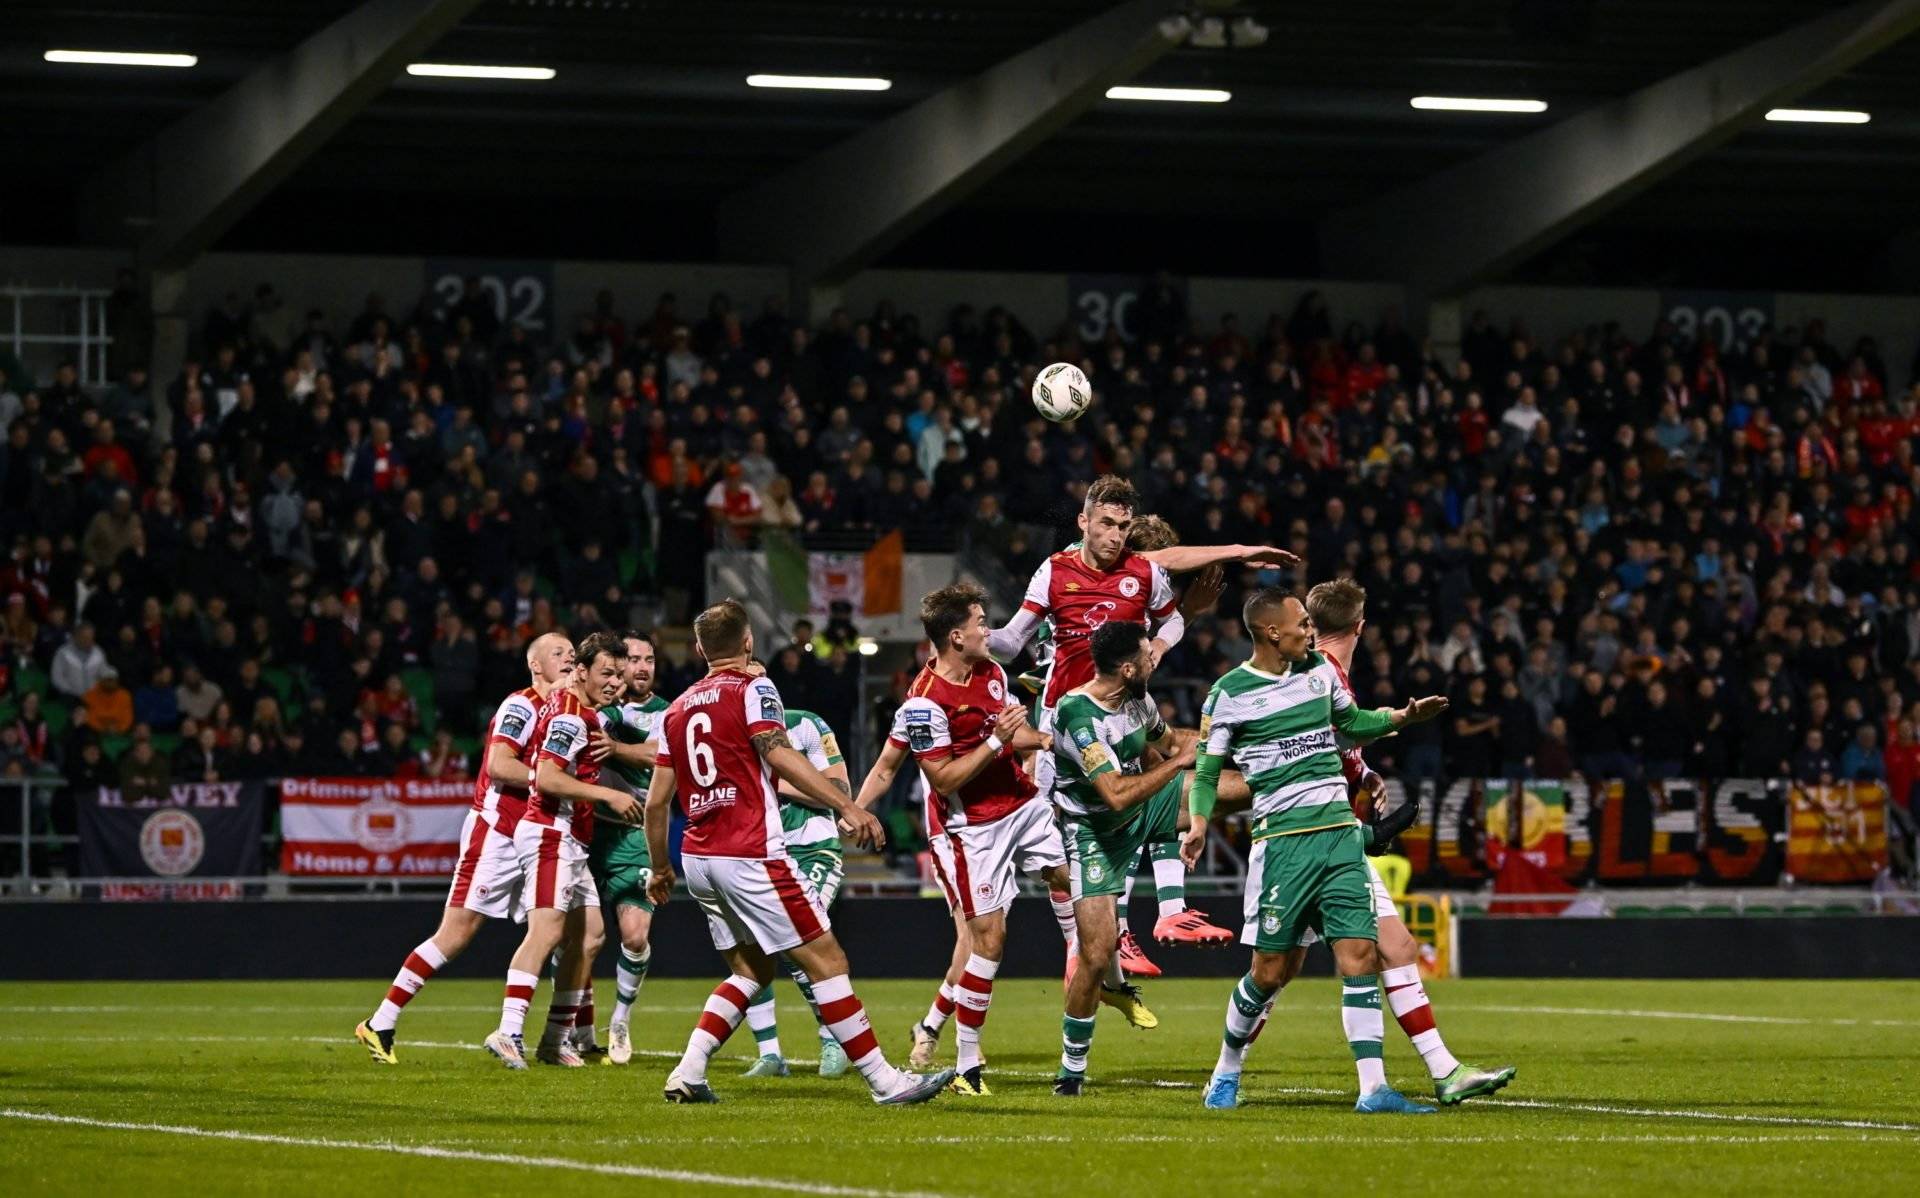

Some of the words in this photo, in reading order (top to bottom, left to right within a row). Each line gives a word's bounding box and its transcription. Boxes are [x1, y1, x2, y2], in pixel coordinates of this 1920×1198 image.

[684, 688, 720, 711] LENNON
[686, 712, 718, 787] 6
[99, 781, 242, 807] HVEY
[282, 778, 399, 801] Drimnagh
[293, 851, 370, 873] Home
[374, 854, 394, 873] &
[400, 854, 459, 874] Awa
